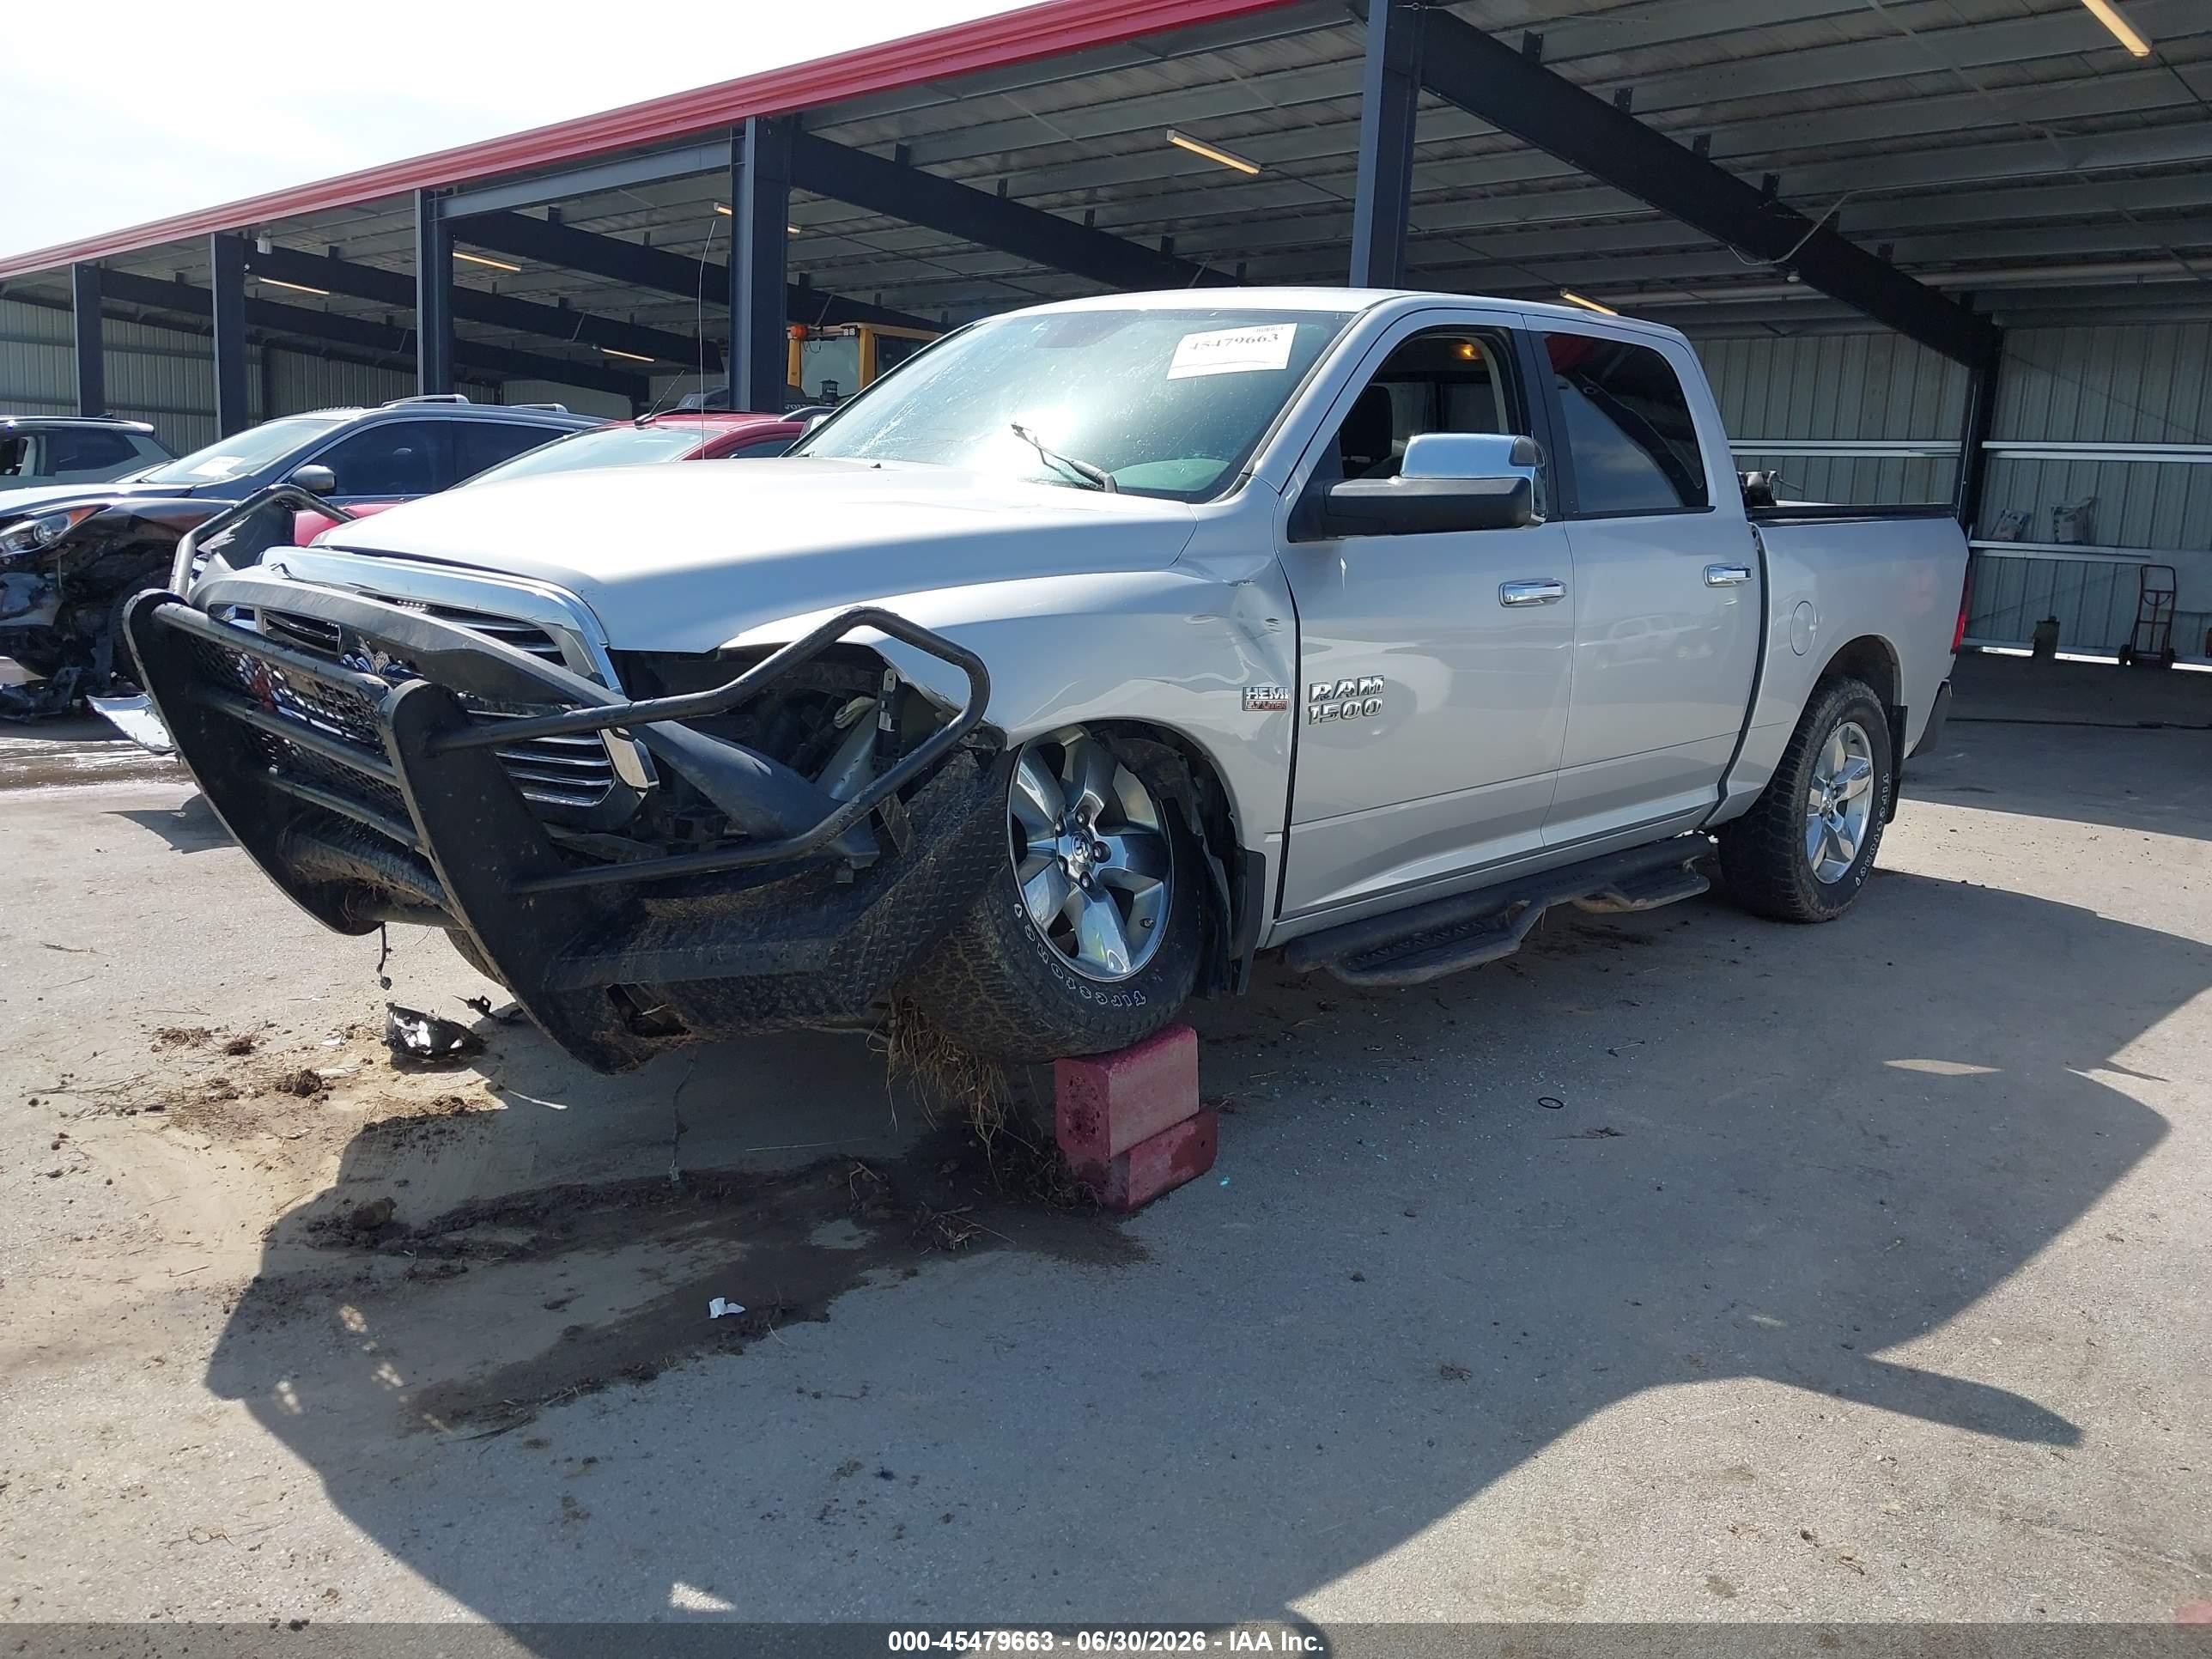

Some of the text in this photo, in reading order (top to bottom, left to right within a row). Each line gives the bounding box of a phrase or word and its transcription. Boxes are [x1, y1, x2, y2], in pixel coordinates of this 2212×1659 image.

[1245, 687, 1289, 700] HEMI
[1309, 674, 1385, 702] RAM
[1308, 696, 1384, 725] 1500
